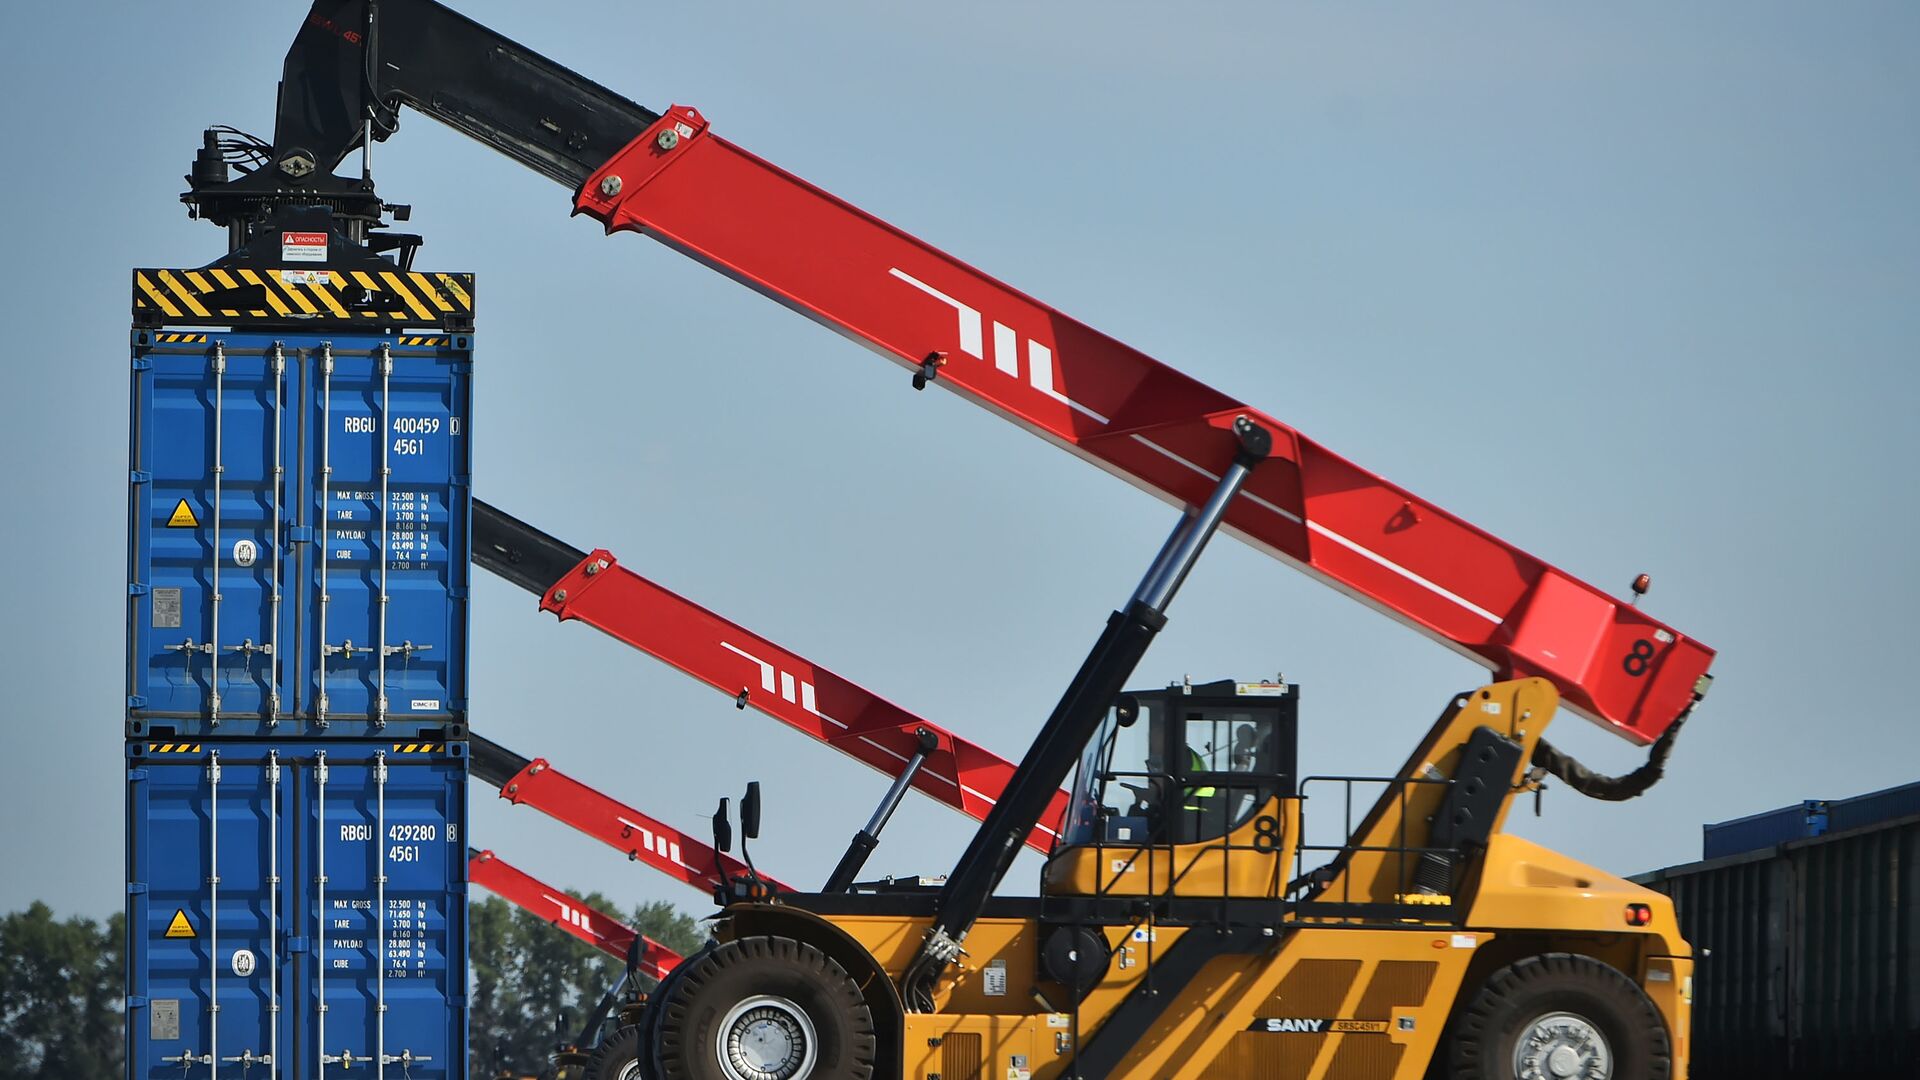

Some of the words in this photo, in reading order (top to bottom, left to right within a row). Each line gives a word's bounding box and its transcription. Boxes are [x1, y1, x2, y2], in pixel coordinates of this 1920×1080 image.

[344, 417, 376, 432] RBGU
[393, 417, 440, 433] 400459
[451, 418, 459, 434] 0
[393, 439, 423, 455] 45G1
[337, 491, 351, 500] MAX
[354, 491, 374, 500] GROSS
[392, 492, 414, 501] 32.500
[421, 493, 429, 503] kg
[392, 502, 414, 511] 71.650
[421, 502, 427, 511] lb
[337, 511, 353, 519] TARE
[396, 512, 414, 520] 3.700
[421, 513, 429, 522] kg
[395, 522, 414, 530] 8.160
[421, 522, 427, 530] lb
[336, 530, 366, 539] PAYLOAD
[392, 532, 414, 540] 28.800
[421, 532, 429, 542] kg
[392, 542, 414, 550] 63.490
[420, 542, 427, 550] lb
[336, 550, 351, 559] CUBE
[395, 551, 410, 560] 76.4
[392, 561, 410, 570] 2.700
[1623, 639, 1655, 677] 8
[340, 825, 372, 841] RBGU
[389, 825, 435, 841] 429280
[448, 825, 456, 841] 8
[1253, 815, 1278, 854] 8
[389, 846, 419, 862] 45G1
[334, 900, 348, 909] MAX
[351, 900, 371, 909] GROSS
[389, 900, 411, 909] 32.500
[418, 901, 426, 911] kg
[389, 910, 411, 919] 71.650
[418, 911, 424, 919] lb
[334, 920, 350, 928] TARE
[392, 920, 411, 928] 3.700
[418, 920, 426, 930] kg
[392, 930, 410, 938] 8.160
[418, 930, 424, 938] lb
[333, 939, 363, 948] PAYLOAD
[388, 940, 410, 948] 28.800
[418, 940, 426, 951] kg
[388, 950, 410, 958] 63.490
[418, 950, 424, 958] lb
[333, 960, 349, 968] CUBE
[392, 960, 407, 968] 76.4
[1267, 1018, 1323, 1032] SANY
